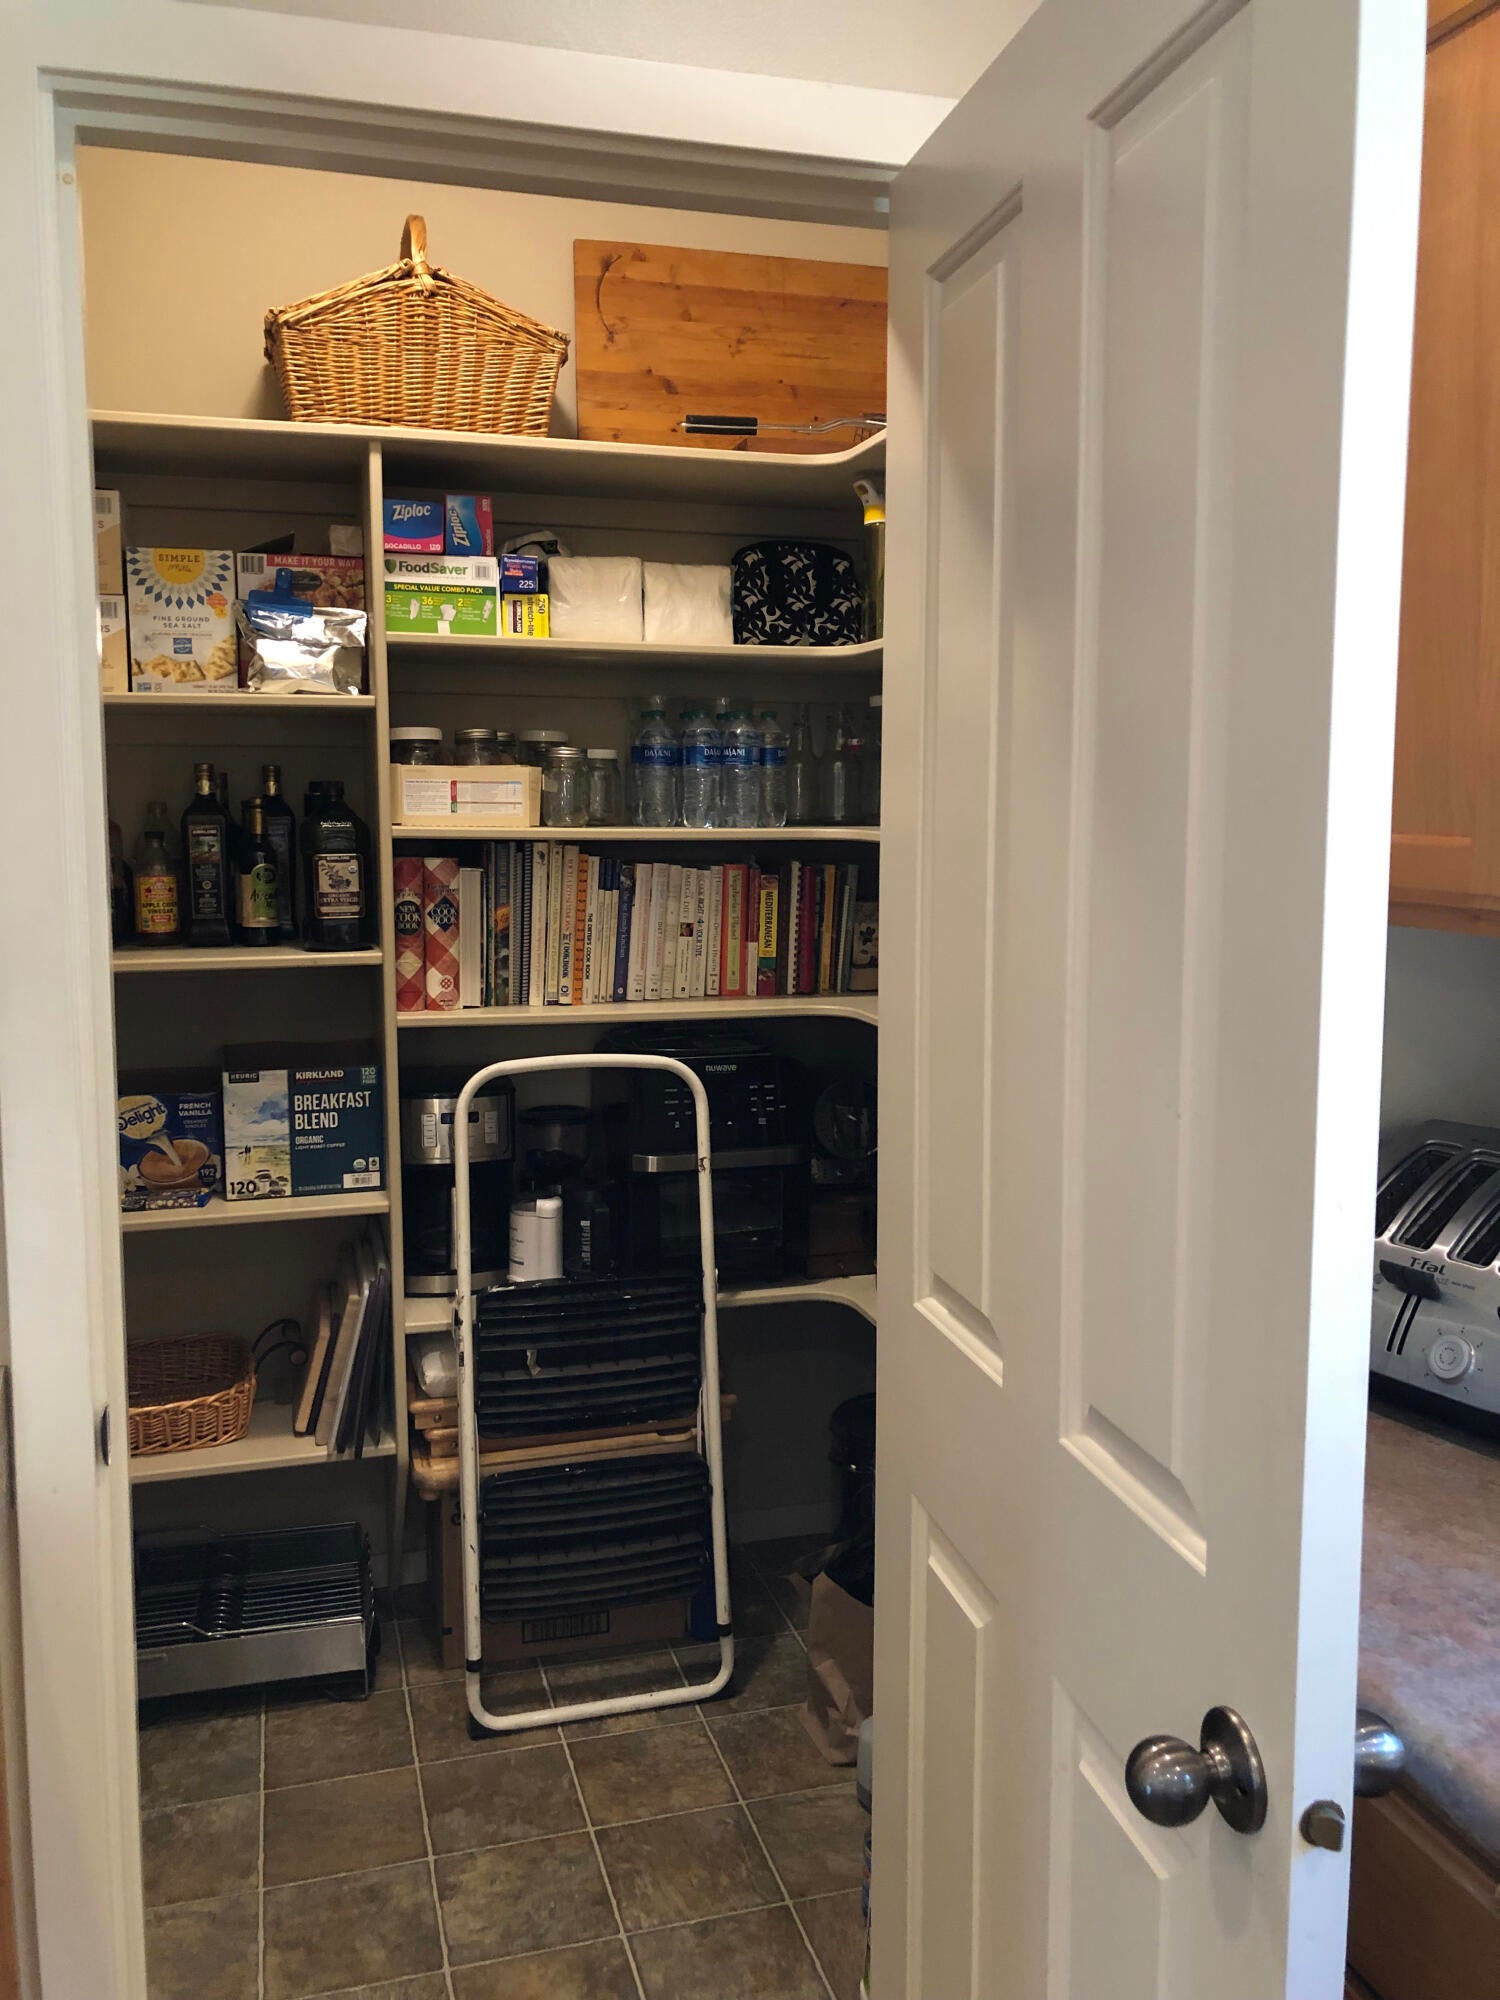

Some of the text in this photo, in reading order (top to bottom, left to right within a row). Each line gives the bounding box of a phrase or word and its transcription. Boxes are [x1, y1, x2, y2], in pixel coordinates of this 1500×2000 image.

[392, 504, 431, 522] Ziploc
[449, 509, 471, 547] Ziploc
[158, 553, 201, 564] SIMPLE
[274, 556, 356, 567] MAKE IT YOUR WAY
[398, 560, 468, 575] FoodSaver
[393, 583, 419, 591] SPECIAL
[519, 580, 534, 589] 225
[385, 595, 392, 603] 3
[421, 596, 434, 605] 36
[457, 598, 464, 607] 2
[537, 597, 546, 614] 750
[644, 749, 671, 759] DASANI
[764, 891, 774, 949] MEDITERRANEAN
[360, 1067, 376, 1076] 120
[705, 1063, 737, 1073] nuwave
[295, 1069, 345, 1080] KIRKLAND
[178, 1102, 212, 1110] FRENCH
[294, 1090, 372, 1112] BREAKFAST
[118, 1101, 167, 1132] Delight
[178, 1109, 213, 1117] VANILLA
[294, 1112, 339, 1130] BLEND
[295, 1135, 324, 1145] ORGANIC
[200, 1167, 215, 1177] 192
[229, 1180, 257, 1195] 120
[1410, 1256, 1447, 1276] T-fal
